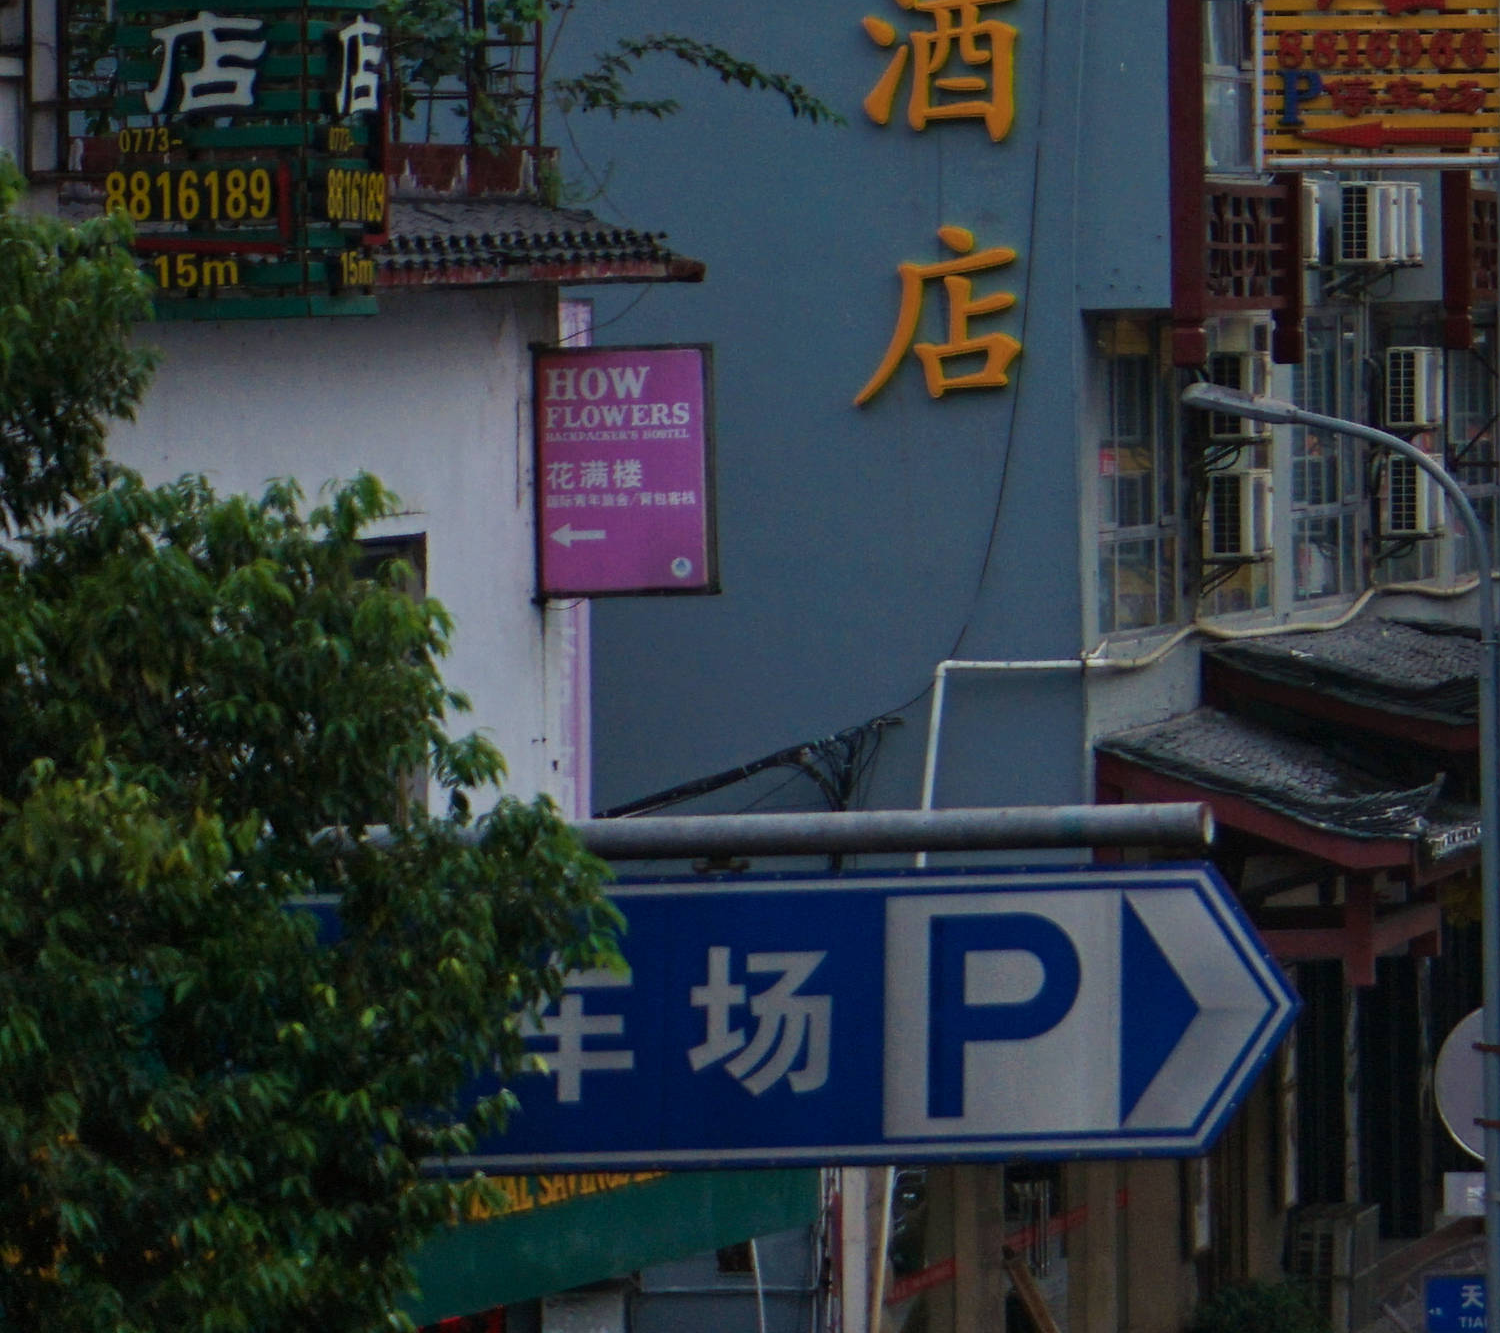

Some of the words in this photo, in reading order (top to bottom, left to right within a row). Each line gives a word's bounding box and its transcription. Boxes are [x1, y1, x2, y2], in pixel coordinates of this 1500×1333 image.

[1278, 69, 1322, 125] P
[118, 128, 183, 154] 0773-
[103, 168, 271, 221] 8816189
[328, 169, 386, 222] 8816189
[154, 254, 239, 288] 15m
[544, 365, 651, 400] HOW
[544, 401, 691, 429] FLOWERS
[546, 458, 643, 490] 花满楼
[928, 913, 1082, 1120] P
